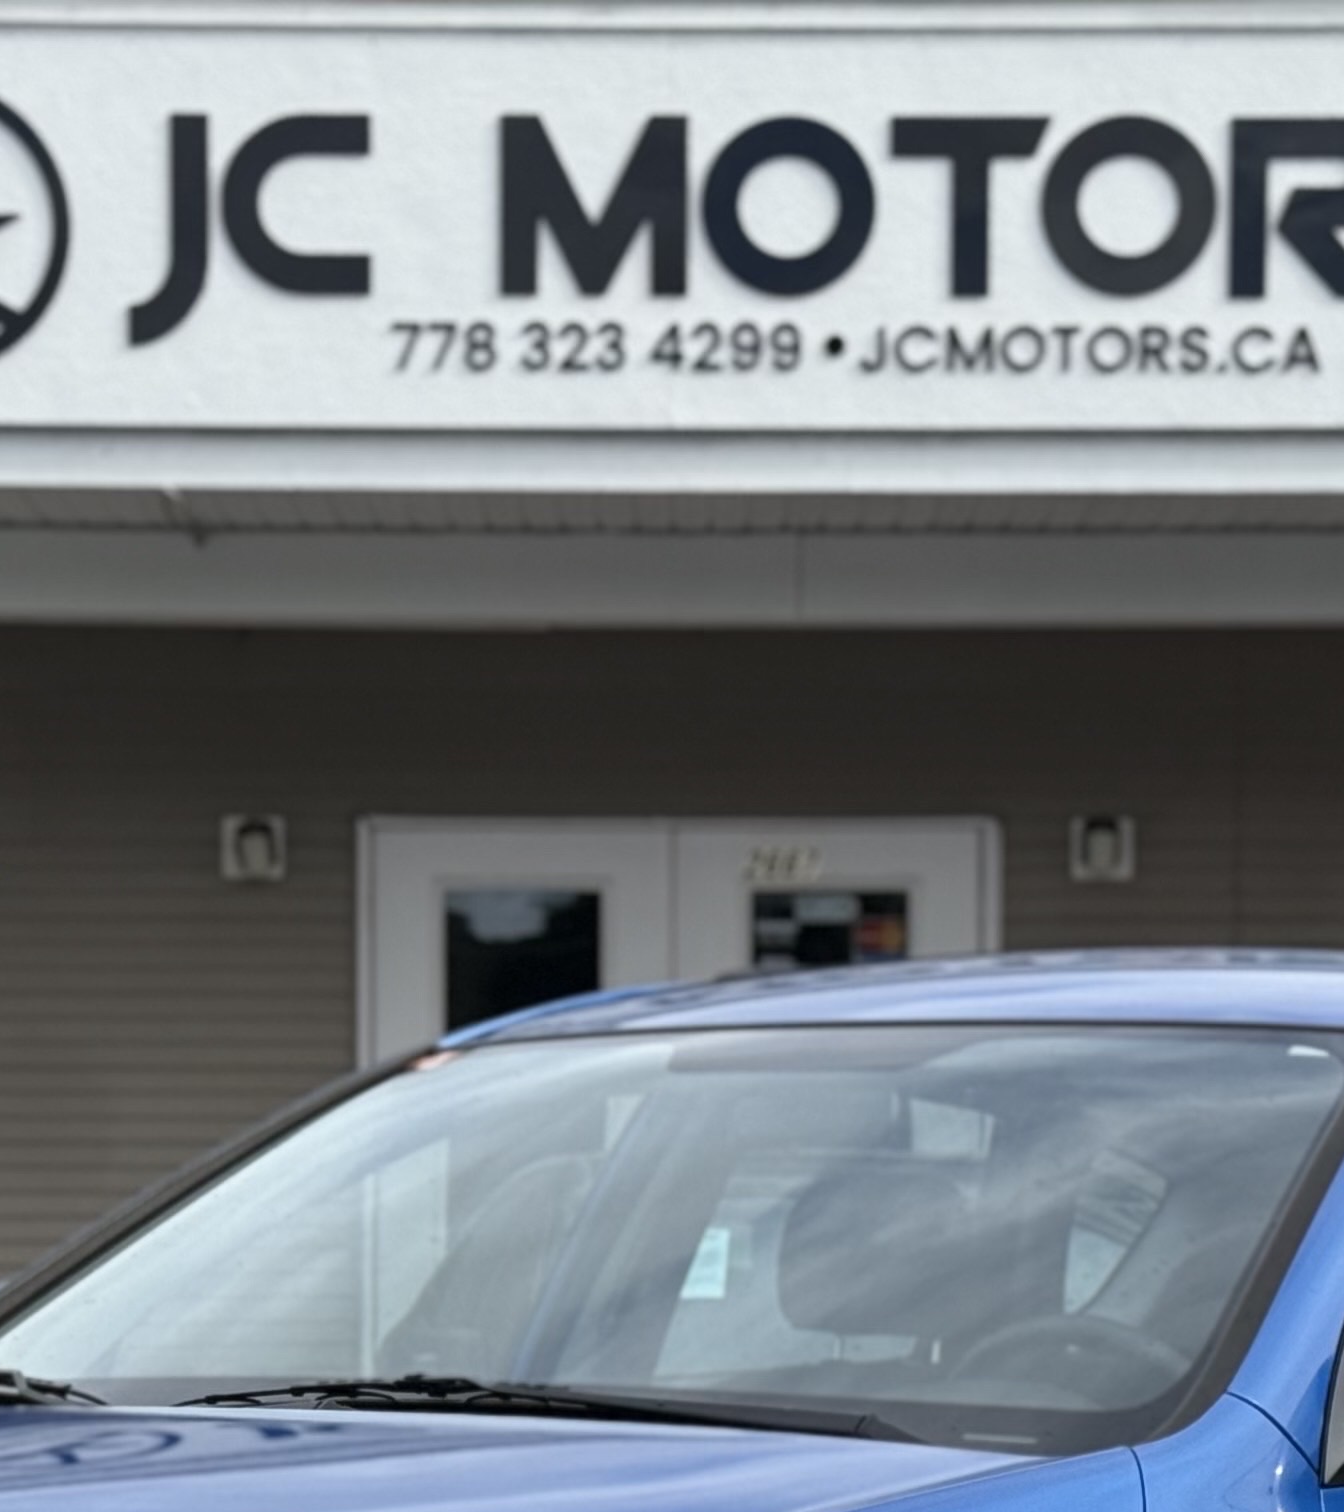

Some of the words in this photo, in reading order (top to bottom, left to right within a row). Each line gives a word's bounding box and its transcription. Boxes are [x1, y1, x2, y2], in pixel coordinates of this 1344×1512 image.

[128, 113, 371, 347] JC
[392, 321, 497, 374] 778
[521, 321, 626, 374] 323
[649, 321, 802, 374] 4299
[858, 324, 1320, 376] JCMOTORS.CA
